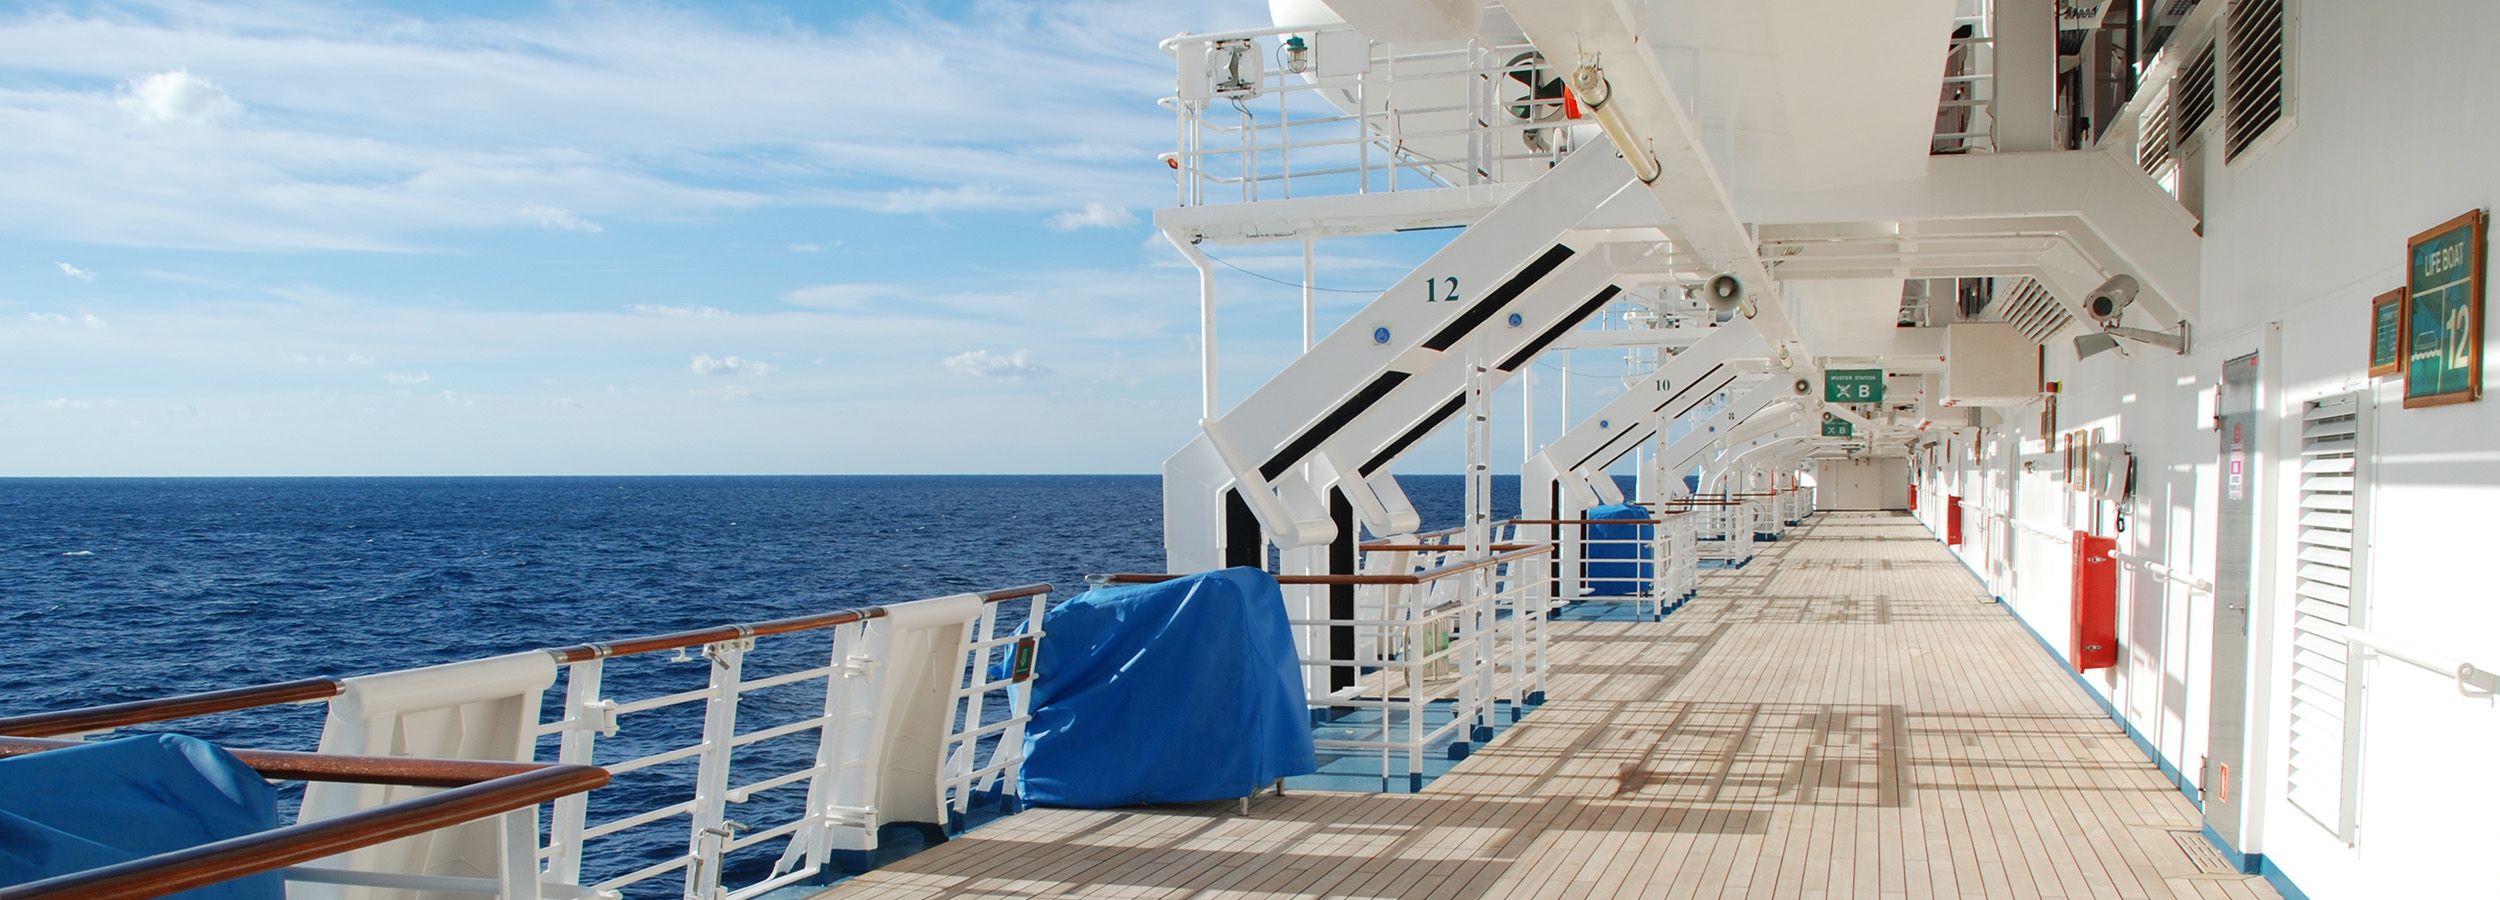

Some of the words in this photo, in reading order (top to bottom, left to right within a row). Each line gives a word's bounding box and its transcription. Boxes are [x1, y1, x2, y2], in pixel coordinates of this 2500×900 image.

[2425, 249, 2442, 277] LIFE
[2442, 242, 2465, 271] BOAT
[1426, 276, 1460, 303] 12
[2446, 304, 2470, 370] 12
[1656, 379, 1671, 392] 10
[1858, 384, 1870, 398] B
[1728, 412, 1735, 420] 8
